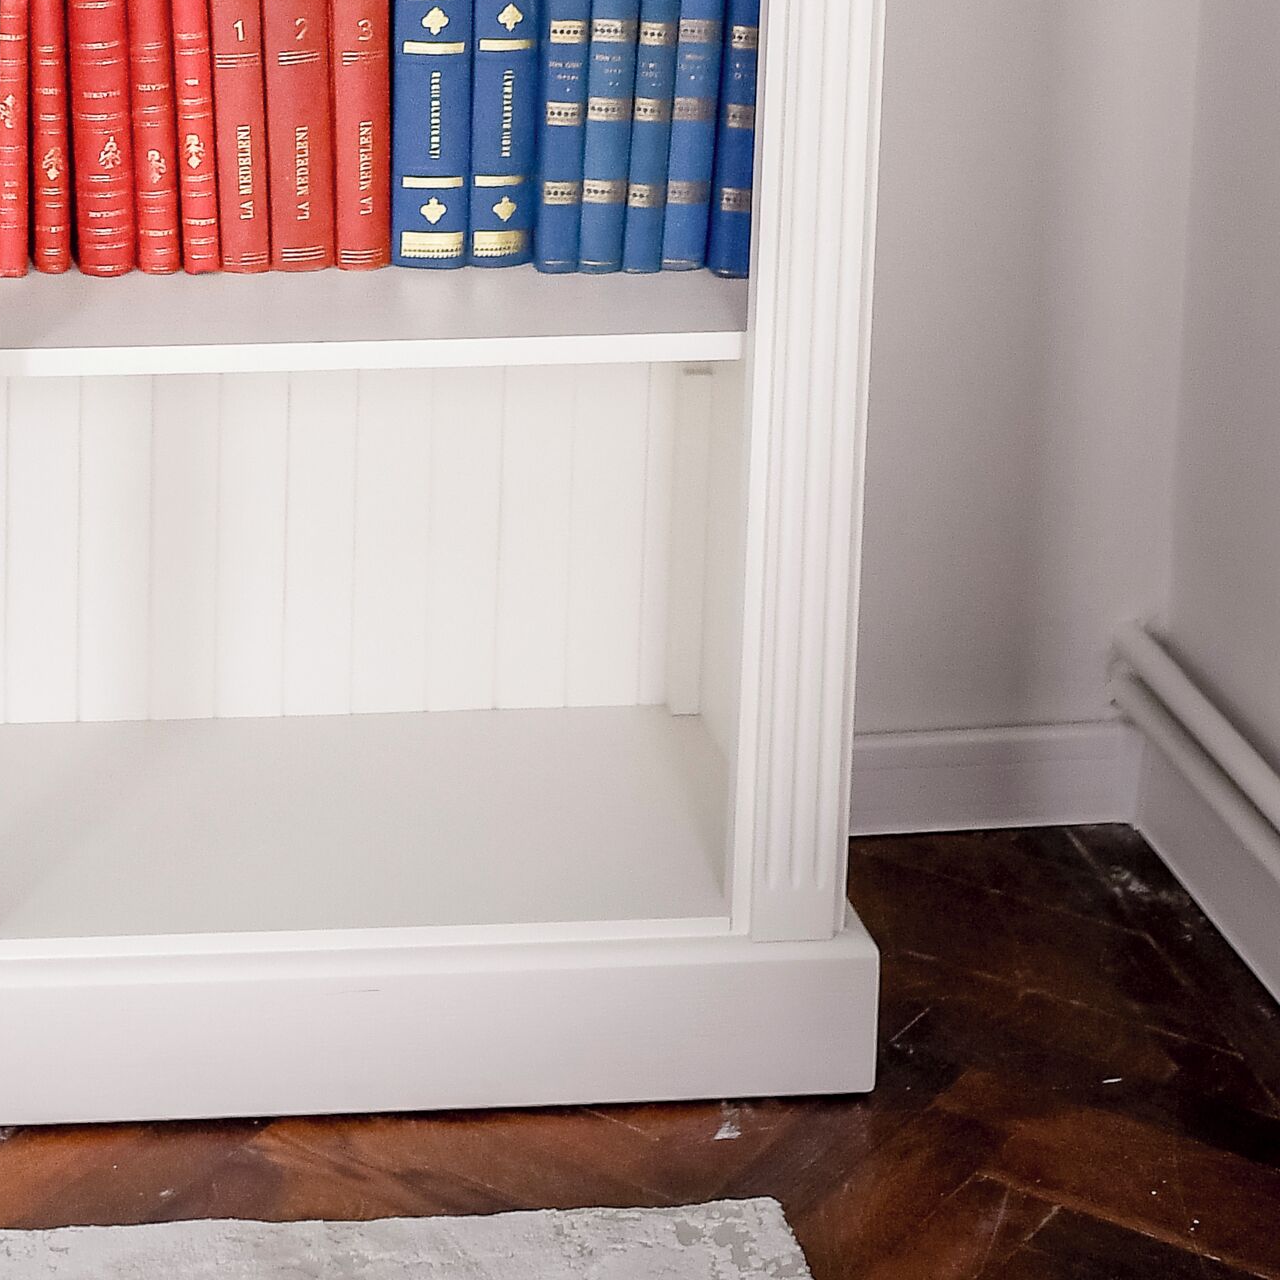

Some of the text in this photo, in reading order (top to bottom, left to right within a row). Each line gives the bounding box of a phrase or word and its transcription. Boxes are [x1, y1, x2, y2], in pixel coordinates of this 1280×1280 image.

[233, 19, 245, 42] 1
[294, 17, 309, 41] 2
[357, 19, 374, 41] 3
[235, 124, 255, 220] LA MEDELENI
[294, 125, 310, 221] LA MEDELENI
[358, 120, 374, 216] LA MEDELENI
